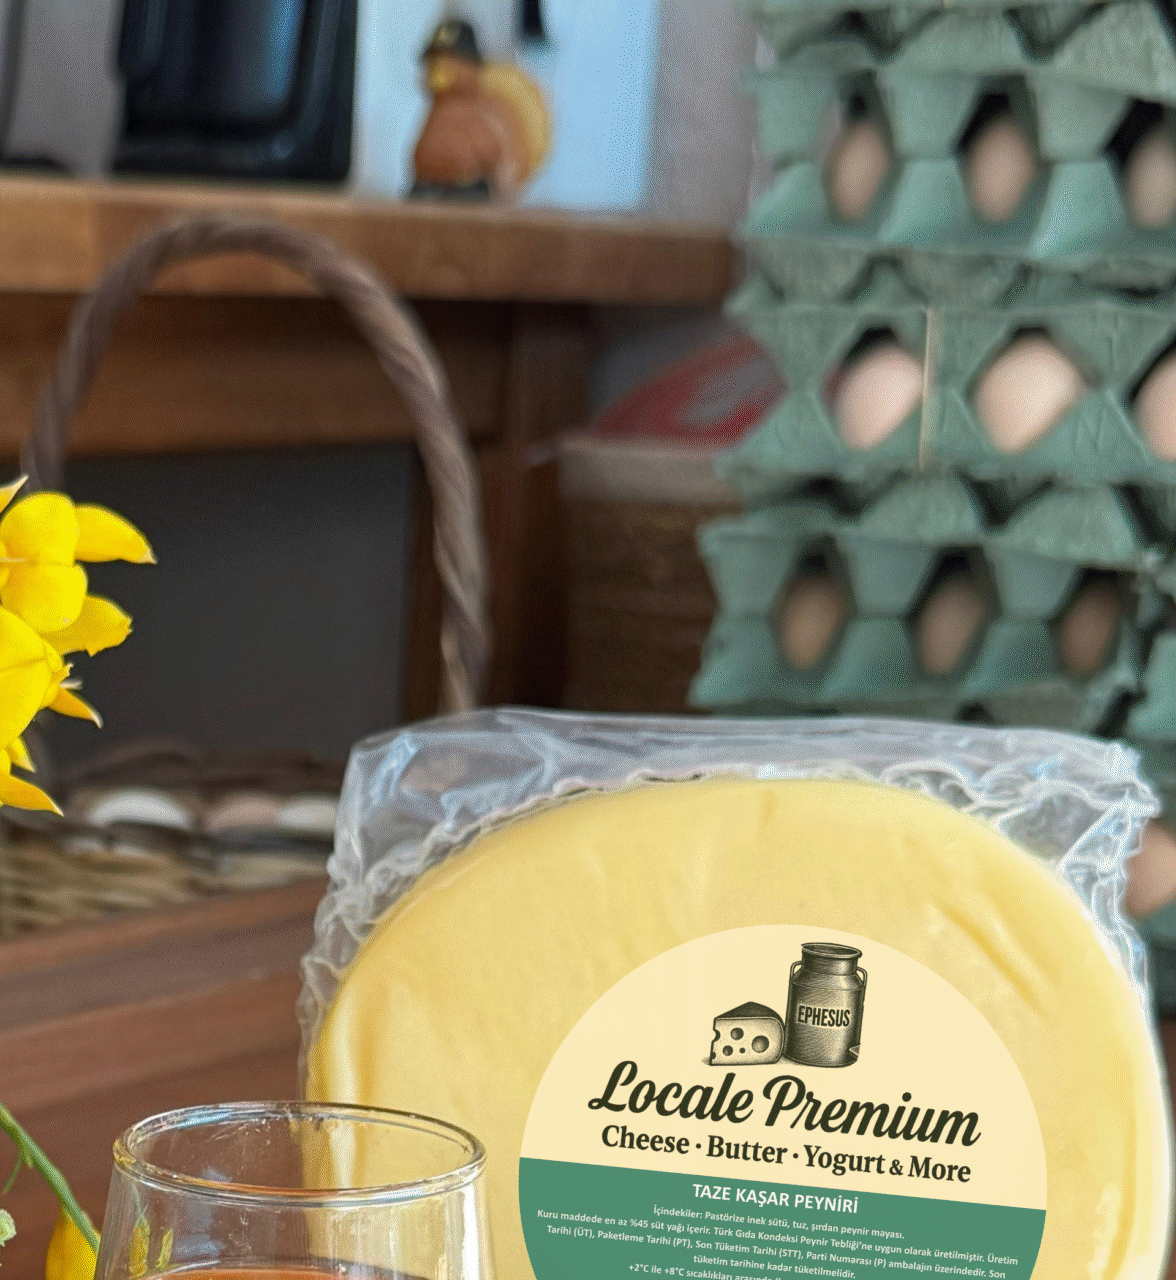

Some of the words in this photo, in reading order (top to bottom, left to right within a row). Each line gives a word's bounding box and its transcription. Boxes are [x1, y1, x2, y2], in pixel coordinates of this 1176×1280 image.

[796, 1005, 851, 1028] EPHESUS
[587, 1060, 754, 1124] Locale
[762, 1075, 982, 1147] Premium
[601, 1125, 690, 1155] Cheese
[706, 1135, 788, 1164] Butter
[803, 1144, 886, 1176] Yogurt
[889, 1159, 904, 1176] &
[907, 1155, 971, 1183] More
[692, 1183, 732, 1201] TAZE
[736, 1188, 790, 1208] KAŞAR
[794, 1194, 859, 1214] PEYNİRİ
[537, 1209, 559, 1219] Kuru
[560, 1213, 603, 1224] maddede
[630, 1218, 649, 1228] %45
[650, 1221, 665, 1230] süt
[667, 1223, 685, 1234] yağı
[686, 1224, 711, 1235] içerir.
[714, 1227, 734, 1237] Türk
[735, 1229, 756, 1239] Gıda
[758, 1231, 798, 1243] Kondeksi
[800, 1236, 829, 1247] Peynir
[874, 1245, 902, 1255] uygun
[904, 1246, 932, 1257] olarak
[934, 1249, 985, 1263] üretilmiştir.
[987, 1253, 1019, 1266] Üretim
[653, 1204, 703, 1219] İçindekiler:
[705, 1211, 745, 1223] Pastörize
[747, 1215, 767, 1225] inek
[768, 1218, 790, 1229] sütü,
[792, 1221, 809, 1231] tuz,
[811, 1223, 839, 1233] şırdan
[840, 1226, 870, 1236] peynir
[871, 1229, 905, 1240] mayası.
[547, 1225, 572, 1235] Tarihi
[573, 1226, 595, 1239] (ÜT),
[597, 1230, 644, 1243] Paketleme
[646, 1235, 671, 1245] Tarihi
[673, 1237, 693, 1249] (PT),
[695, 1240, 713, 1250] Son
[714, 1242, 750, 1253] Tüketim
[752, 1245, 777, 1256] Tarihi
[778, 1248, 804, 1260] (STT),
[806, 1251, 828, 1261] Parti
[829, 1253, 872, 1266] Numarası
[874, 1257, 887, 1269] (P)
[888, 1260, 933, 1273] ambalajın
[934, 1264, 987, 1277] üzerindedir.
[988, 1269, 1006, 1279] Son
[693, 1255, 728, 1266] tüketim
[730, 1259, 765, 1270] tarihine
[767, 1262, 793, 1272] kadar
[794, 1265, 856, 1279] tüketilmelidir.
[651, 1265, 662, 1274] ile
[686, 1270, 733, 1280] sıcaklıkları
